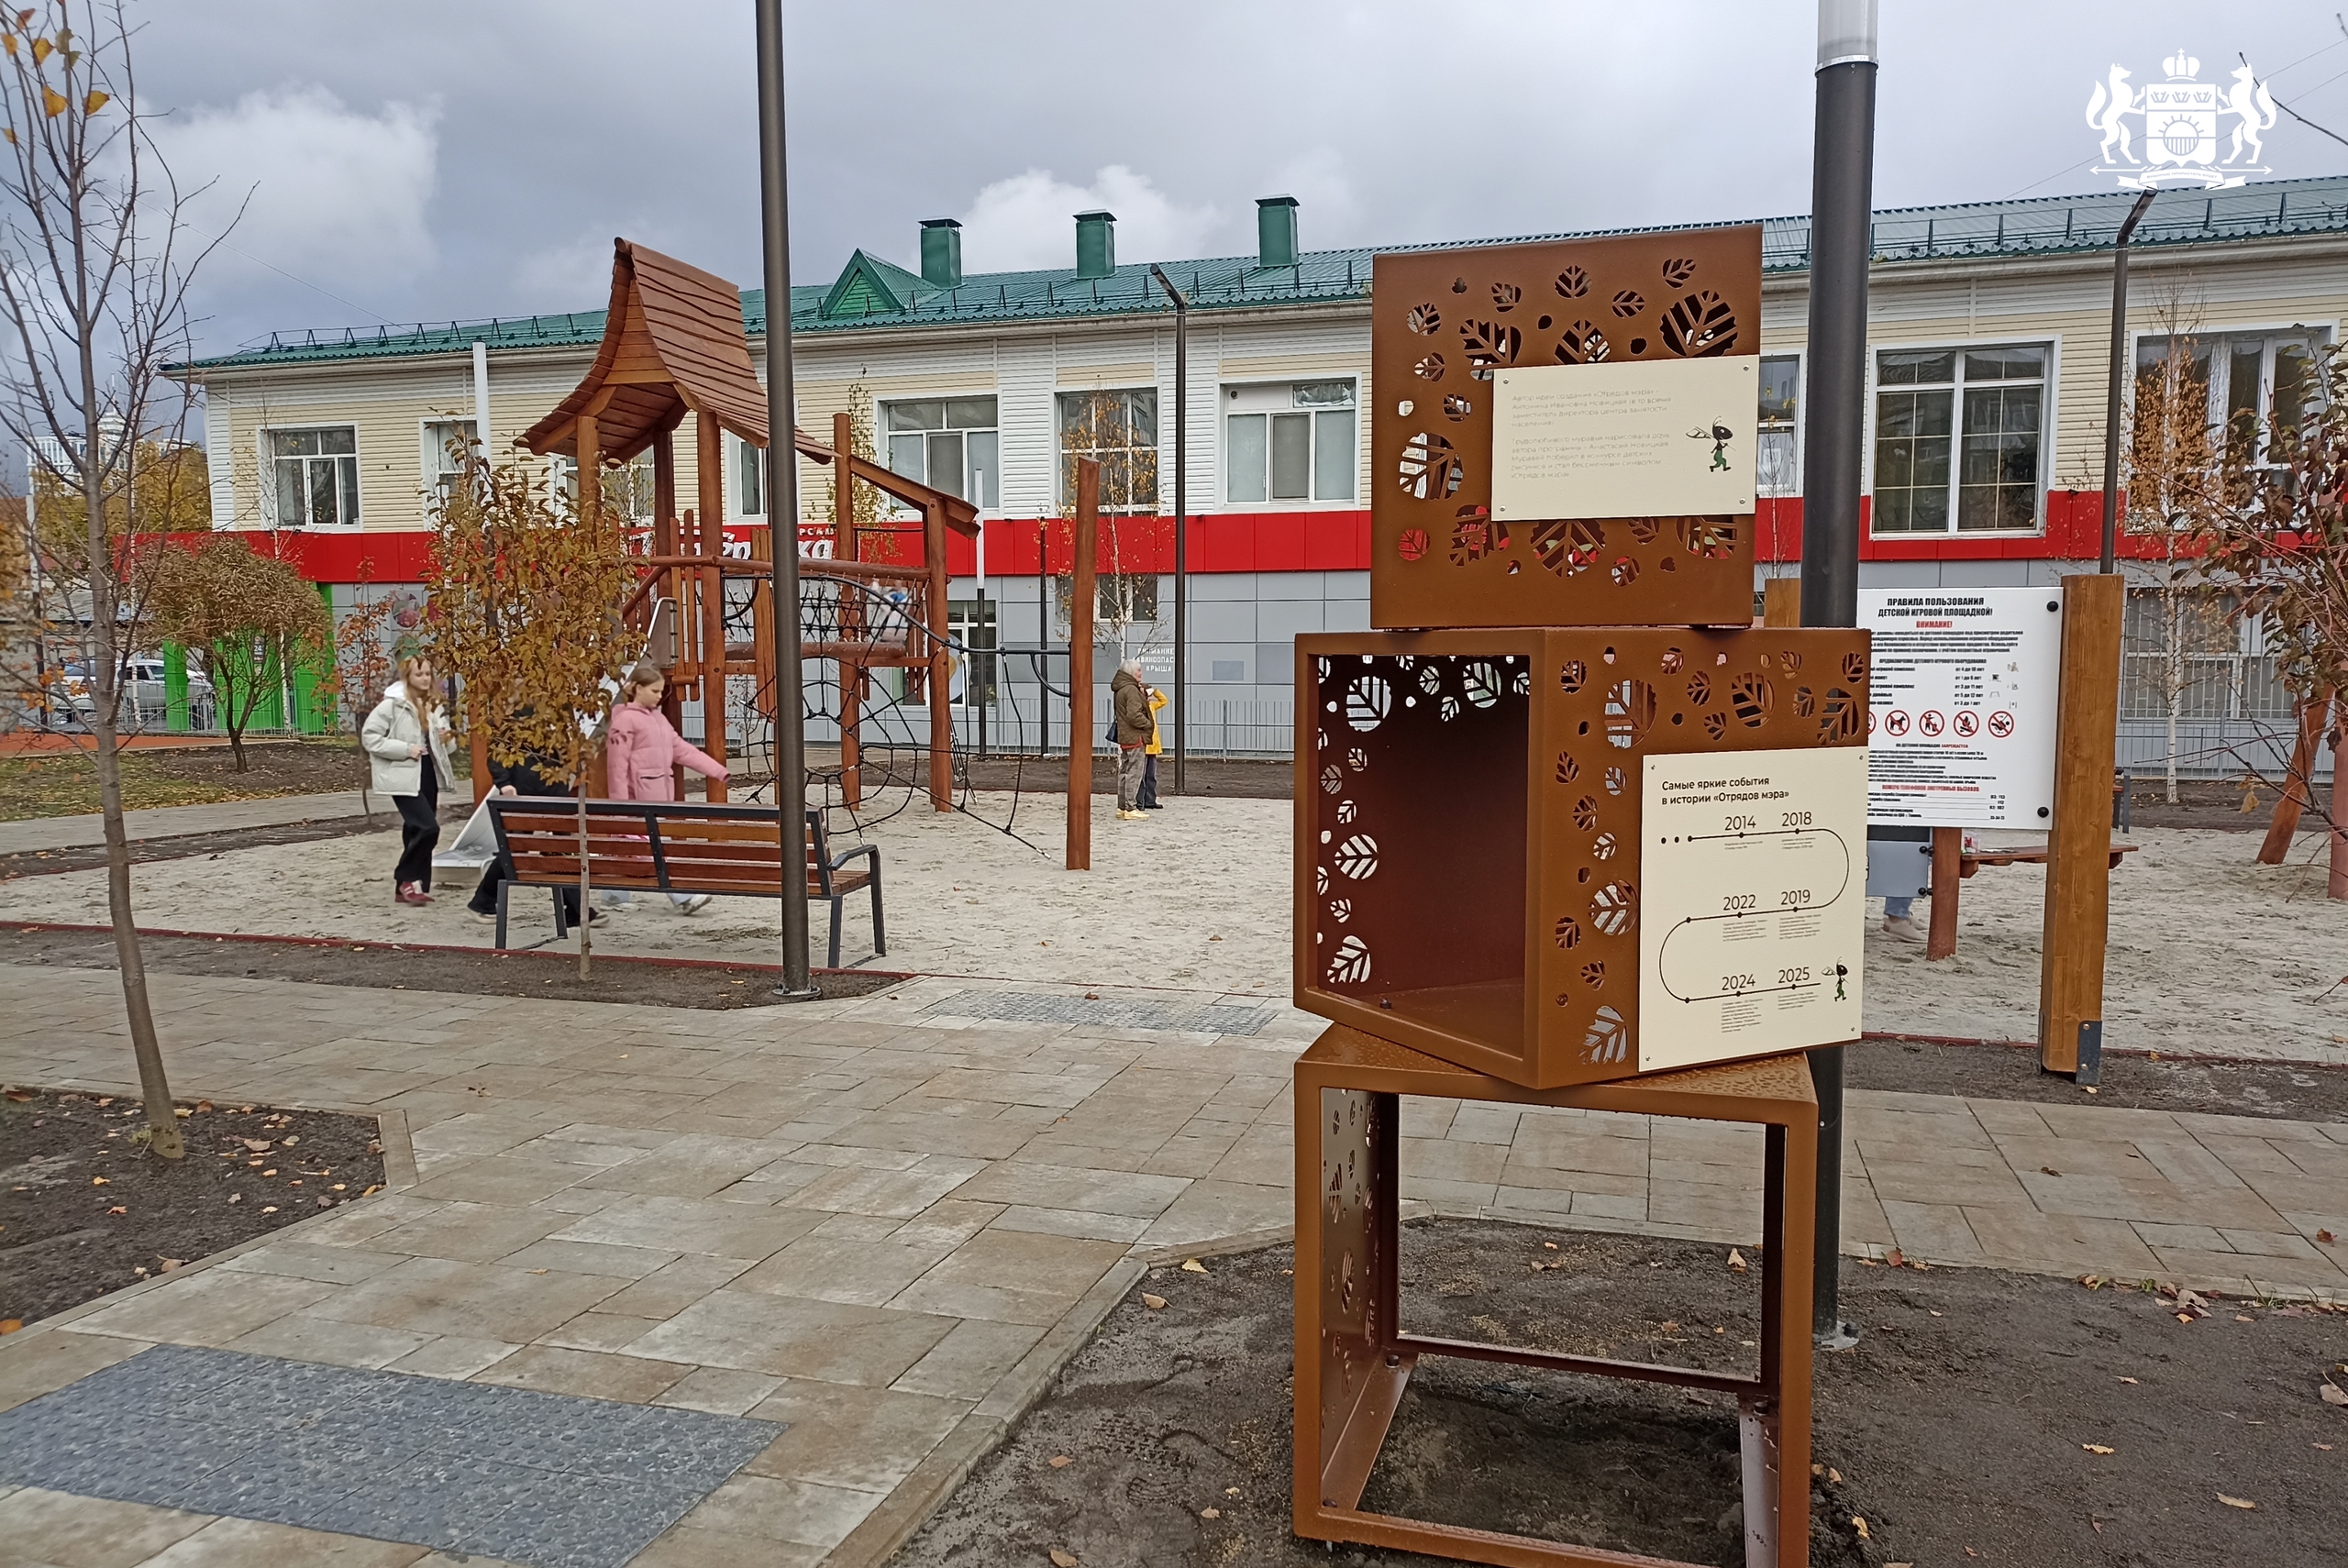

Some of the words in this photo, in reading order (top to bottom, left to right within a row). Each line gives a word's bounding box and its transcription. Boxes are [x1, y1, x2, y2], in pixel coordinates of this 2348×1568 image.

[1887, 598, 1923, 606] ПРАВИЛА
[1924, 597, 1984, 606] ПОЛЬЗОВАНИЯ
[1877, 607, 1910, 617] ДЕТСКОЙ
[1911, 607, 1943, 616] ИГРОВОЙ
[1944, 606, 1992, 617] ПЛОЩАДКОЙ!
[1915, 620, 1953, 628] ВНИМАНИЕ!
[1661, 780, 1695, 790] Самые
[1697, 779, 1727, 790] яркие
[1729, 777, 1769, 787] события
[1661, 797, 1667, 805] в
[1669, 795, 1711, 805] истории
[1712, 792, 1759, 802] «Отрядов
[1761, 790, 1789, 801] мэра»
[1724, 815, 1756, 831] 2014
[1781, 811, 1811, 826] 2018
[1722, 894, 1756, 911] 2022
[1780, 889, 1811, 905] 2019
[1722, 974, 1755, 990] 2024
[1778, 967, 1810, 984] 2025
